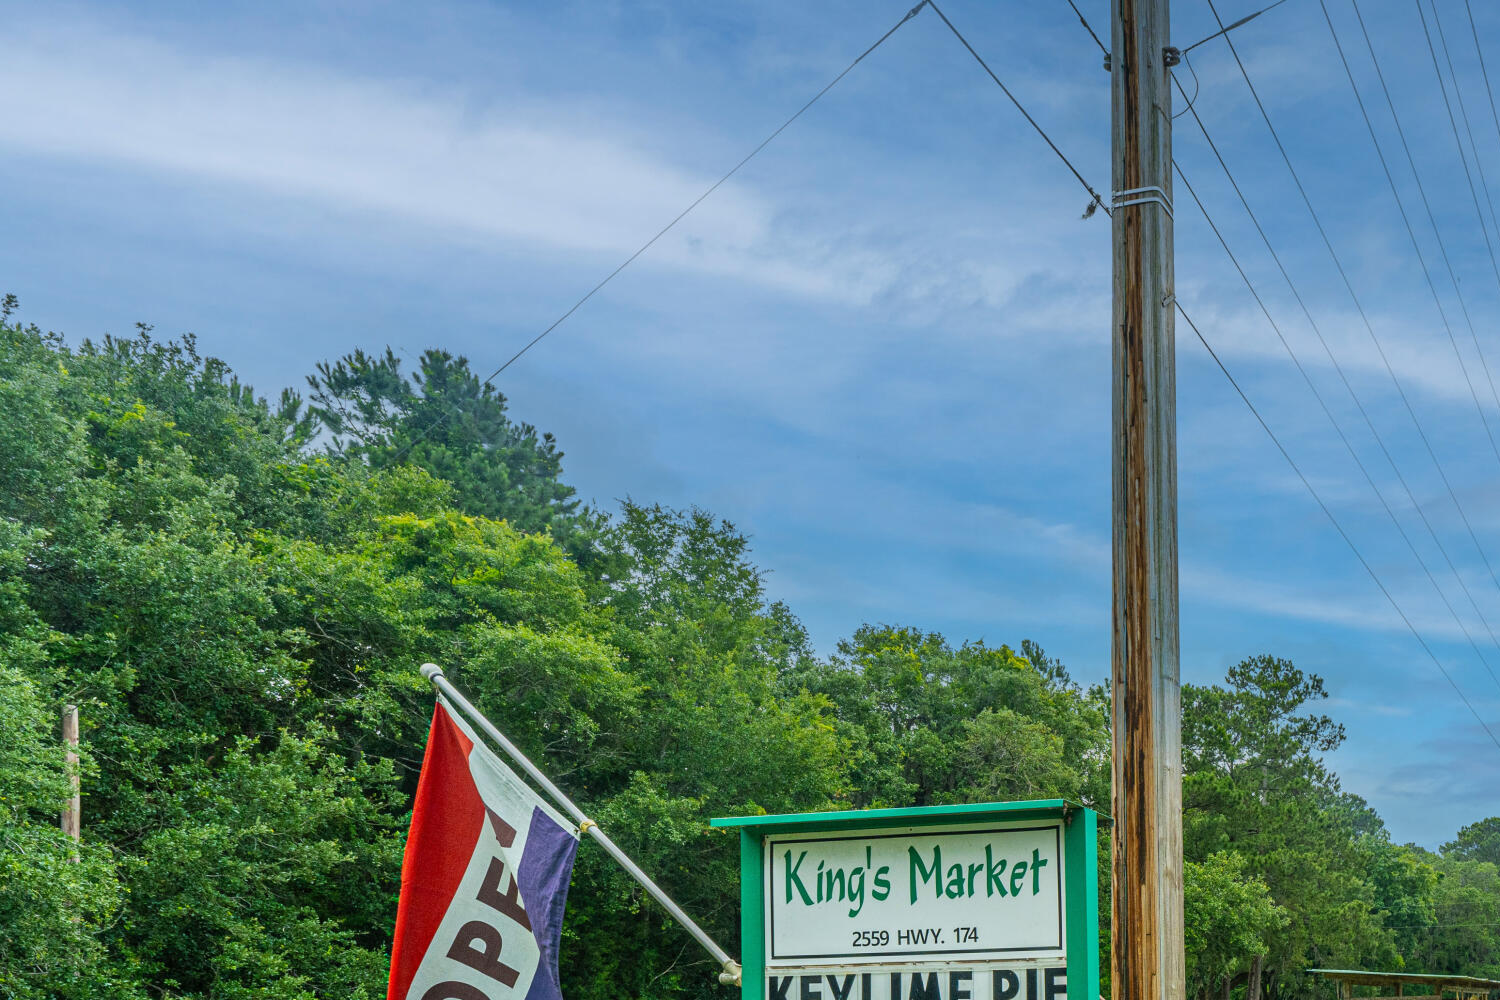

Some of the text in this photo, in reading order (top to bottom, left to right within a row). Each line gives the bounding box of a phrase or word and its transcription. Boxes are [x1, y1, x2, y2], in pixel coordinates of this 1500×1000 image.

[784, 843, 1048, 918] King's Market
[852, 927, 979, 947] 2559 HWY. 174
